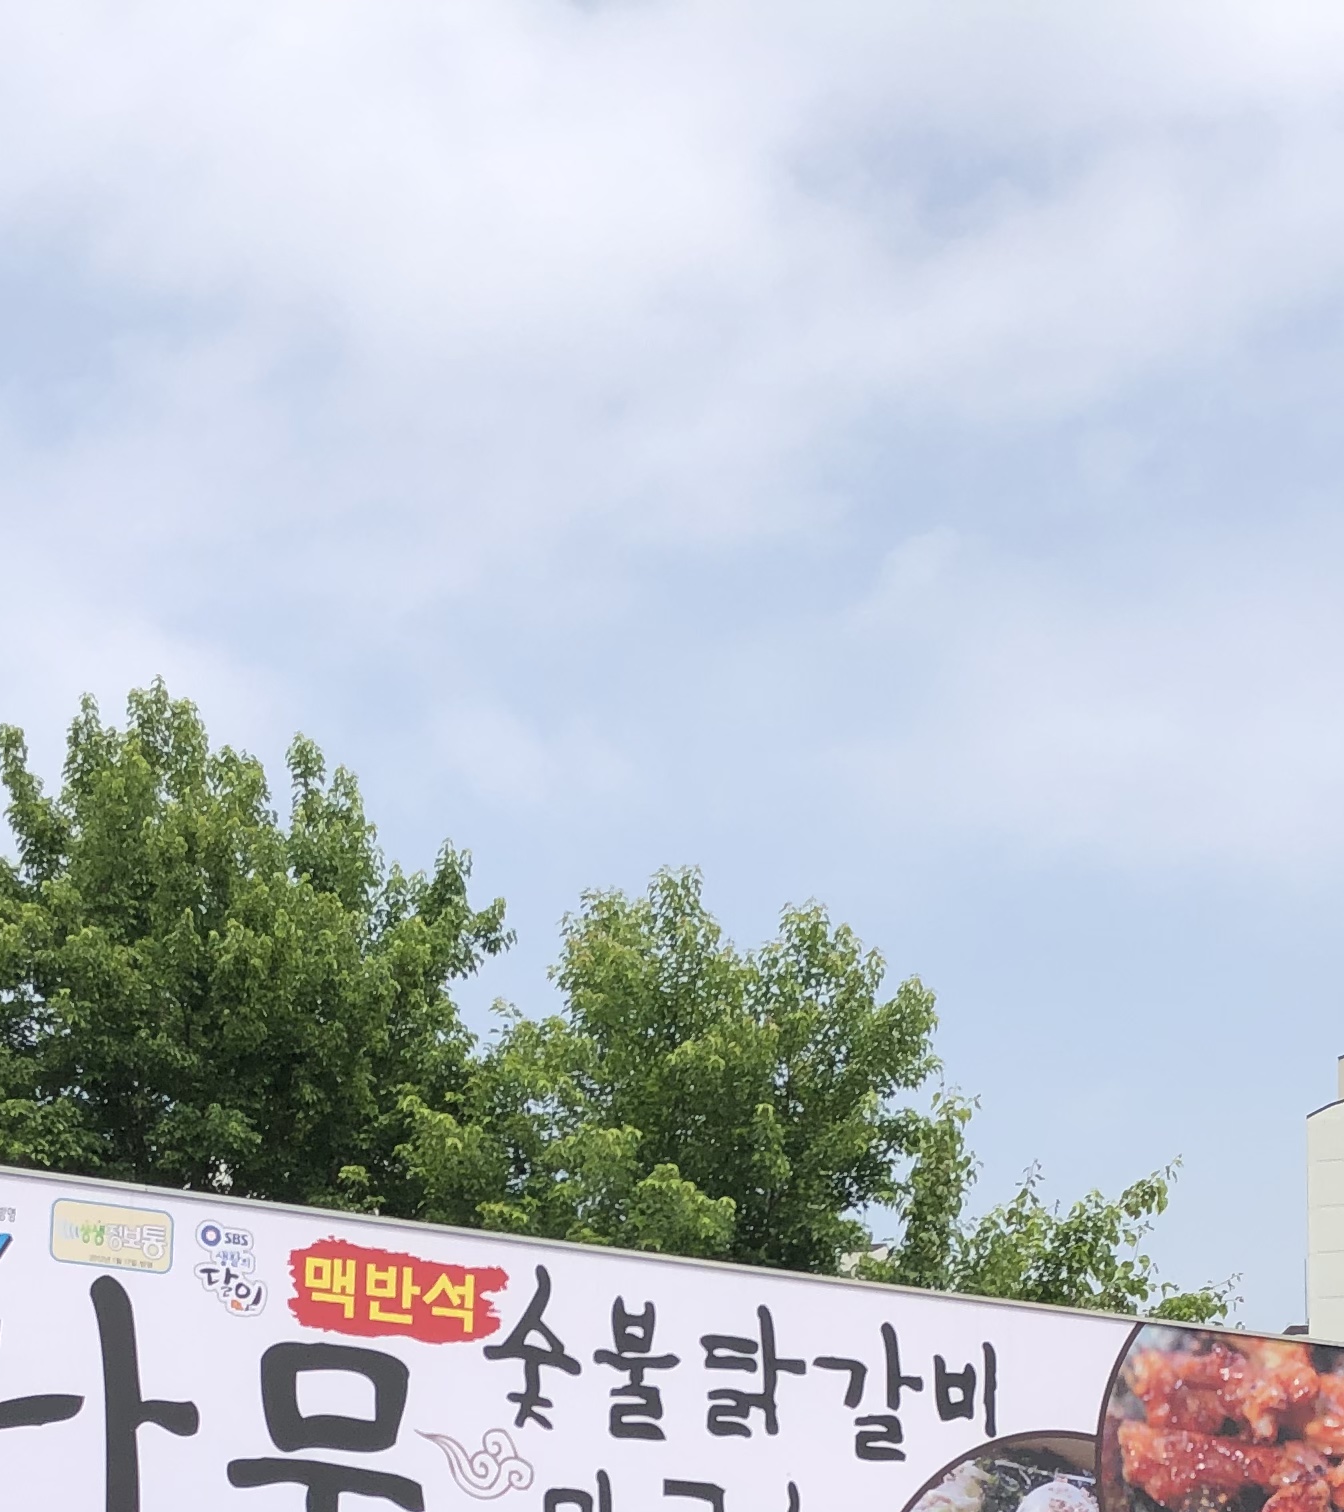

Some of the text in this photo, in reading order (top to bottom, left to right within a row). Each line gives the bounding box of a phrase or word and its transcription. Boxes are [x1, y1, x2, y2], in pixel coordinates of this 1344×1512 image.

[224, 1232, 249, 1247] SBS
[199, 1267, 263, 1311] 달인
[303, 1256, 478, 1333] 맥반석
